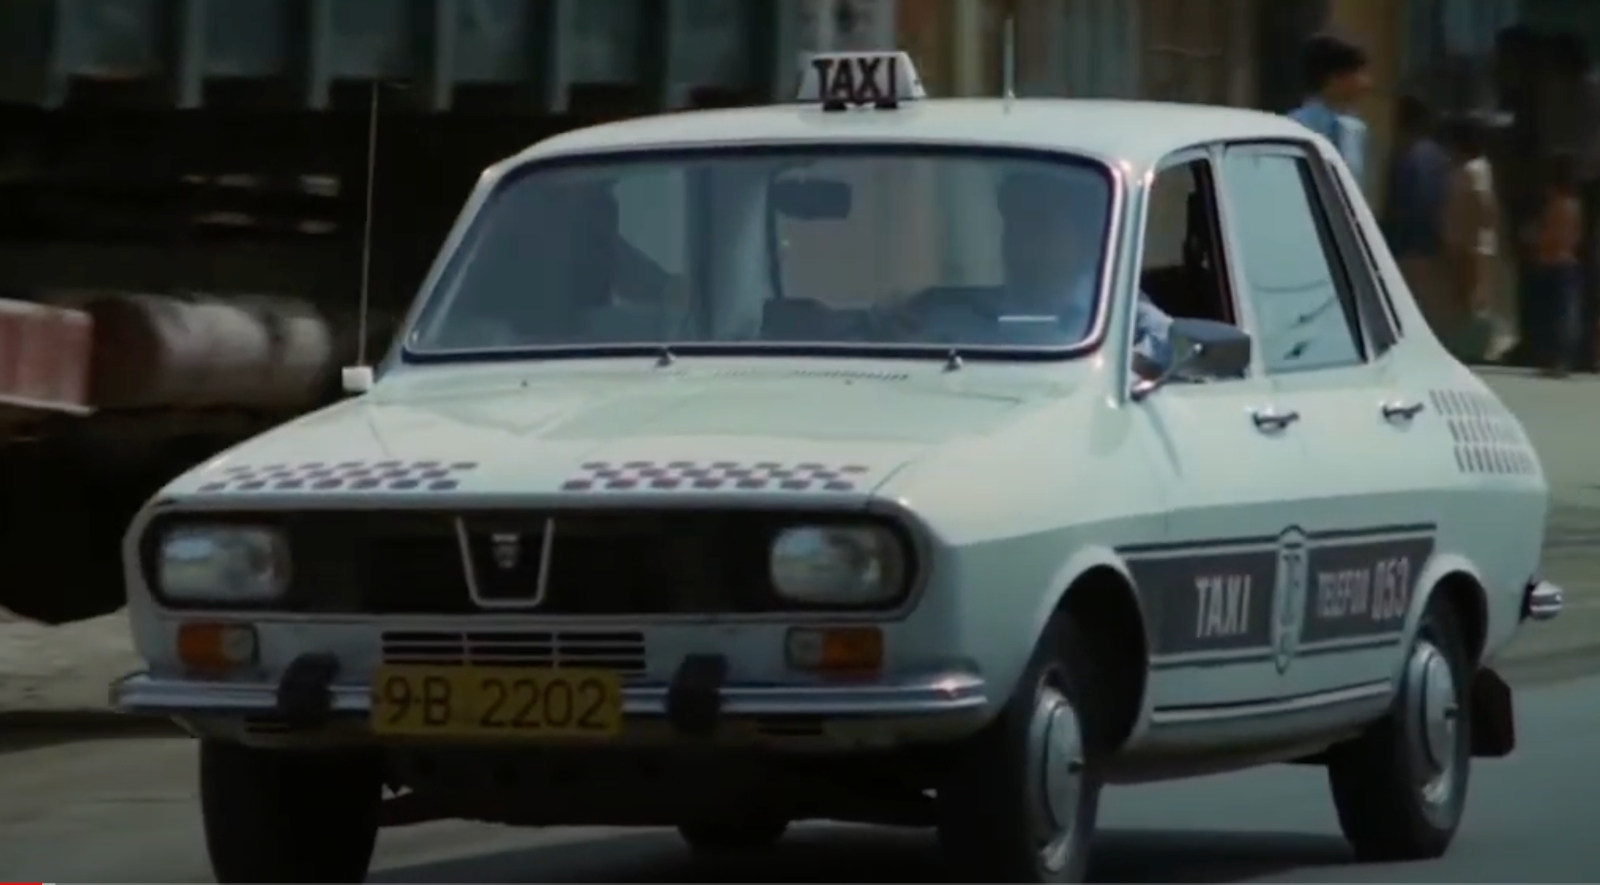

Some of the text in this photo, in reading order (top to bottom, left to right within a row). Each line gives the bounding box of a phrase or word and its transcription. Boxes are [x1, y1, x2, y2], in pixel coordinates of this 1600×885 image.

[811, 57, 897, 102] TAXI
[1194, 574, 1251, 638] TAXI
[1371, 557, 1409, 620] 053
[478, 677, 609, 728] 2202
